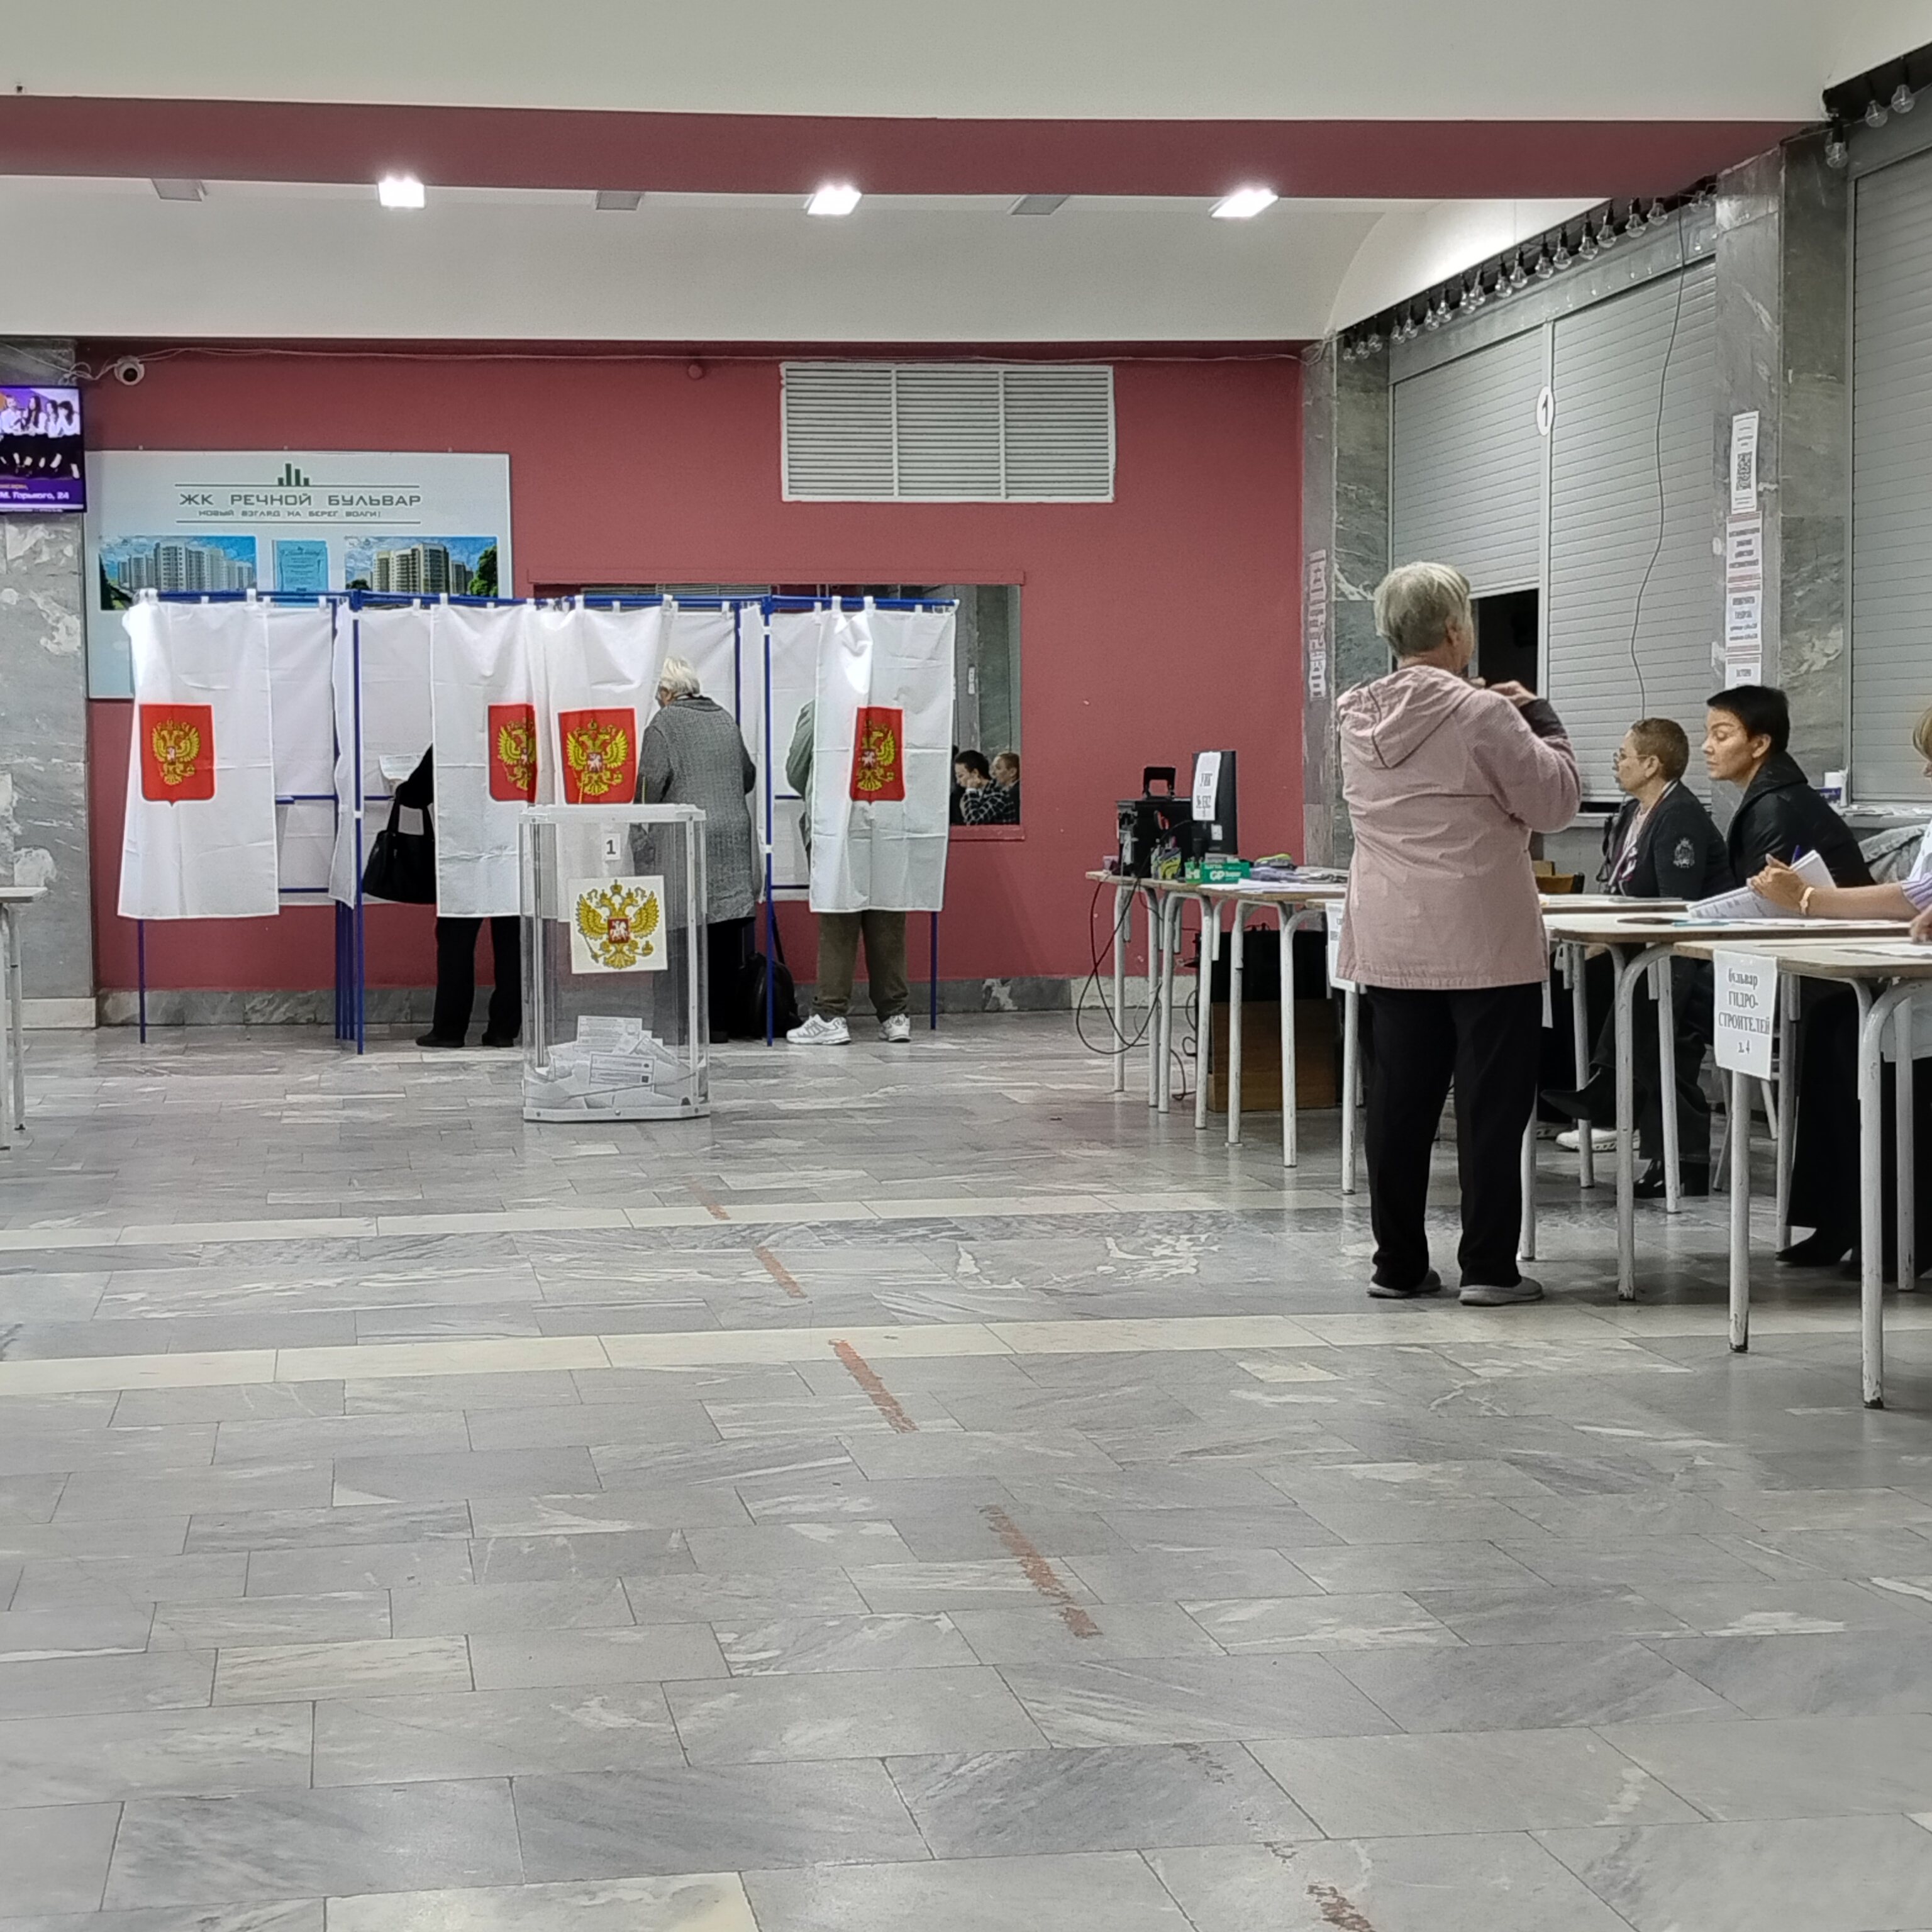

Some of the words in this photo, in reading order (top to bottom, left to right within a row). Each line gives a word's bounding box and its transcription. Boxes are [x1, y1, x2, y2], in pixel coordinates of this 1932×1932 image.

[179, 493, 214, 506] ЖК
[230, 492, 312, 506] РЕЧНОЙ
[328, 494, 421, 506] БУЛЬВАР
[606, 839, 616, 855] 1
[1209, 870, 1226, 881] GP
[1728, 991, 1759, 1009] ГИДРО-
[1718, 1011, 1770, 1035] СТРОИТЕЛЕЙ
